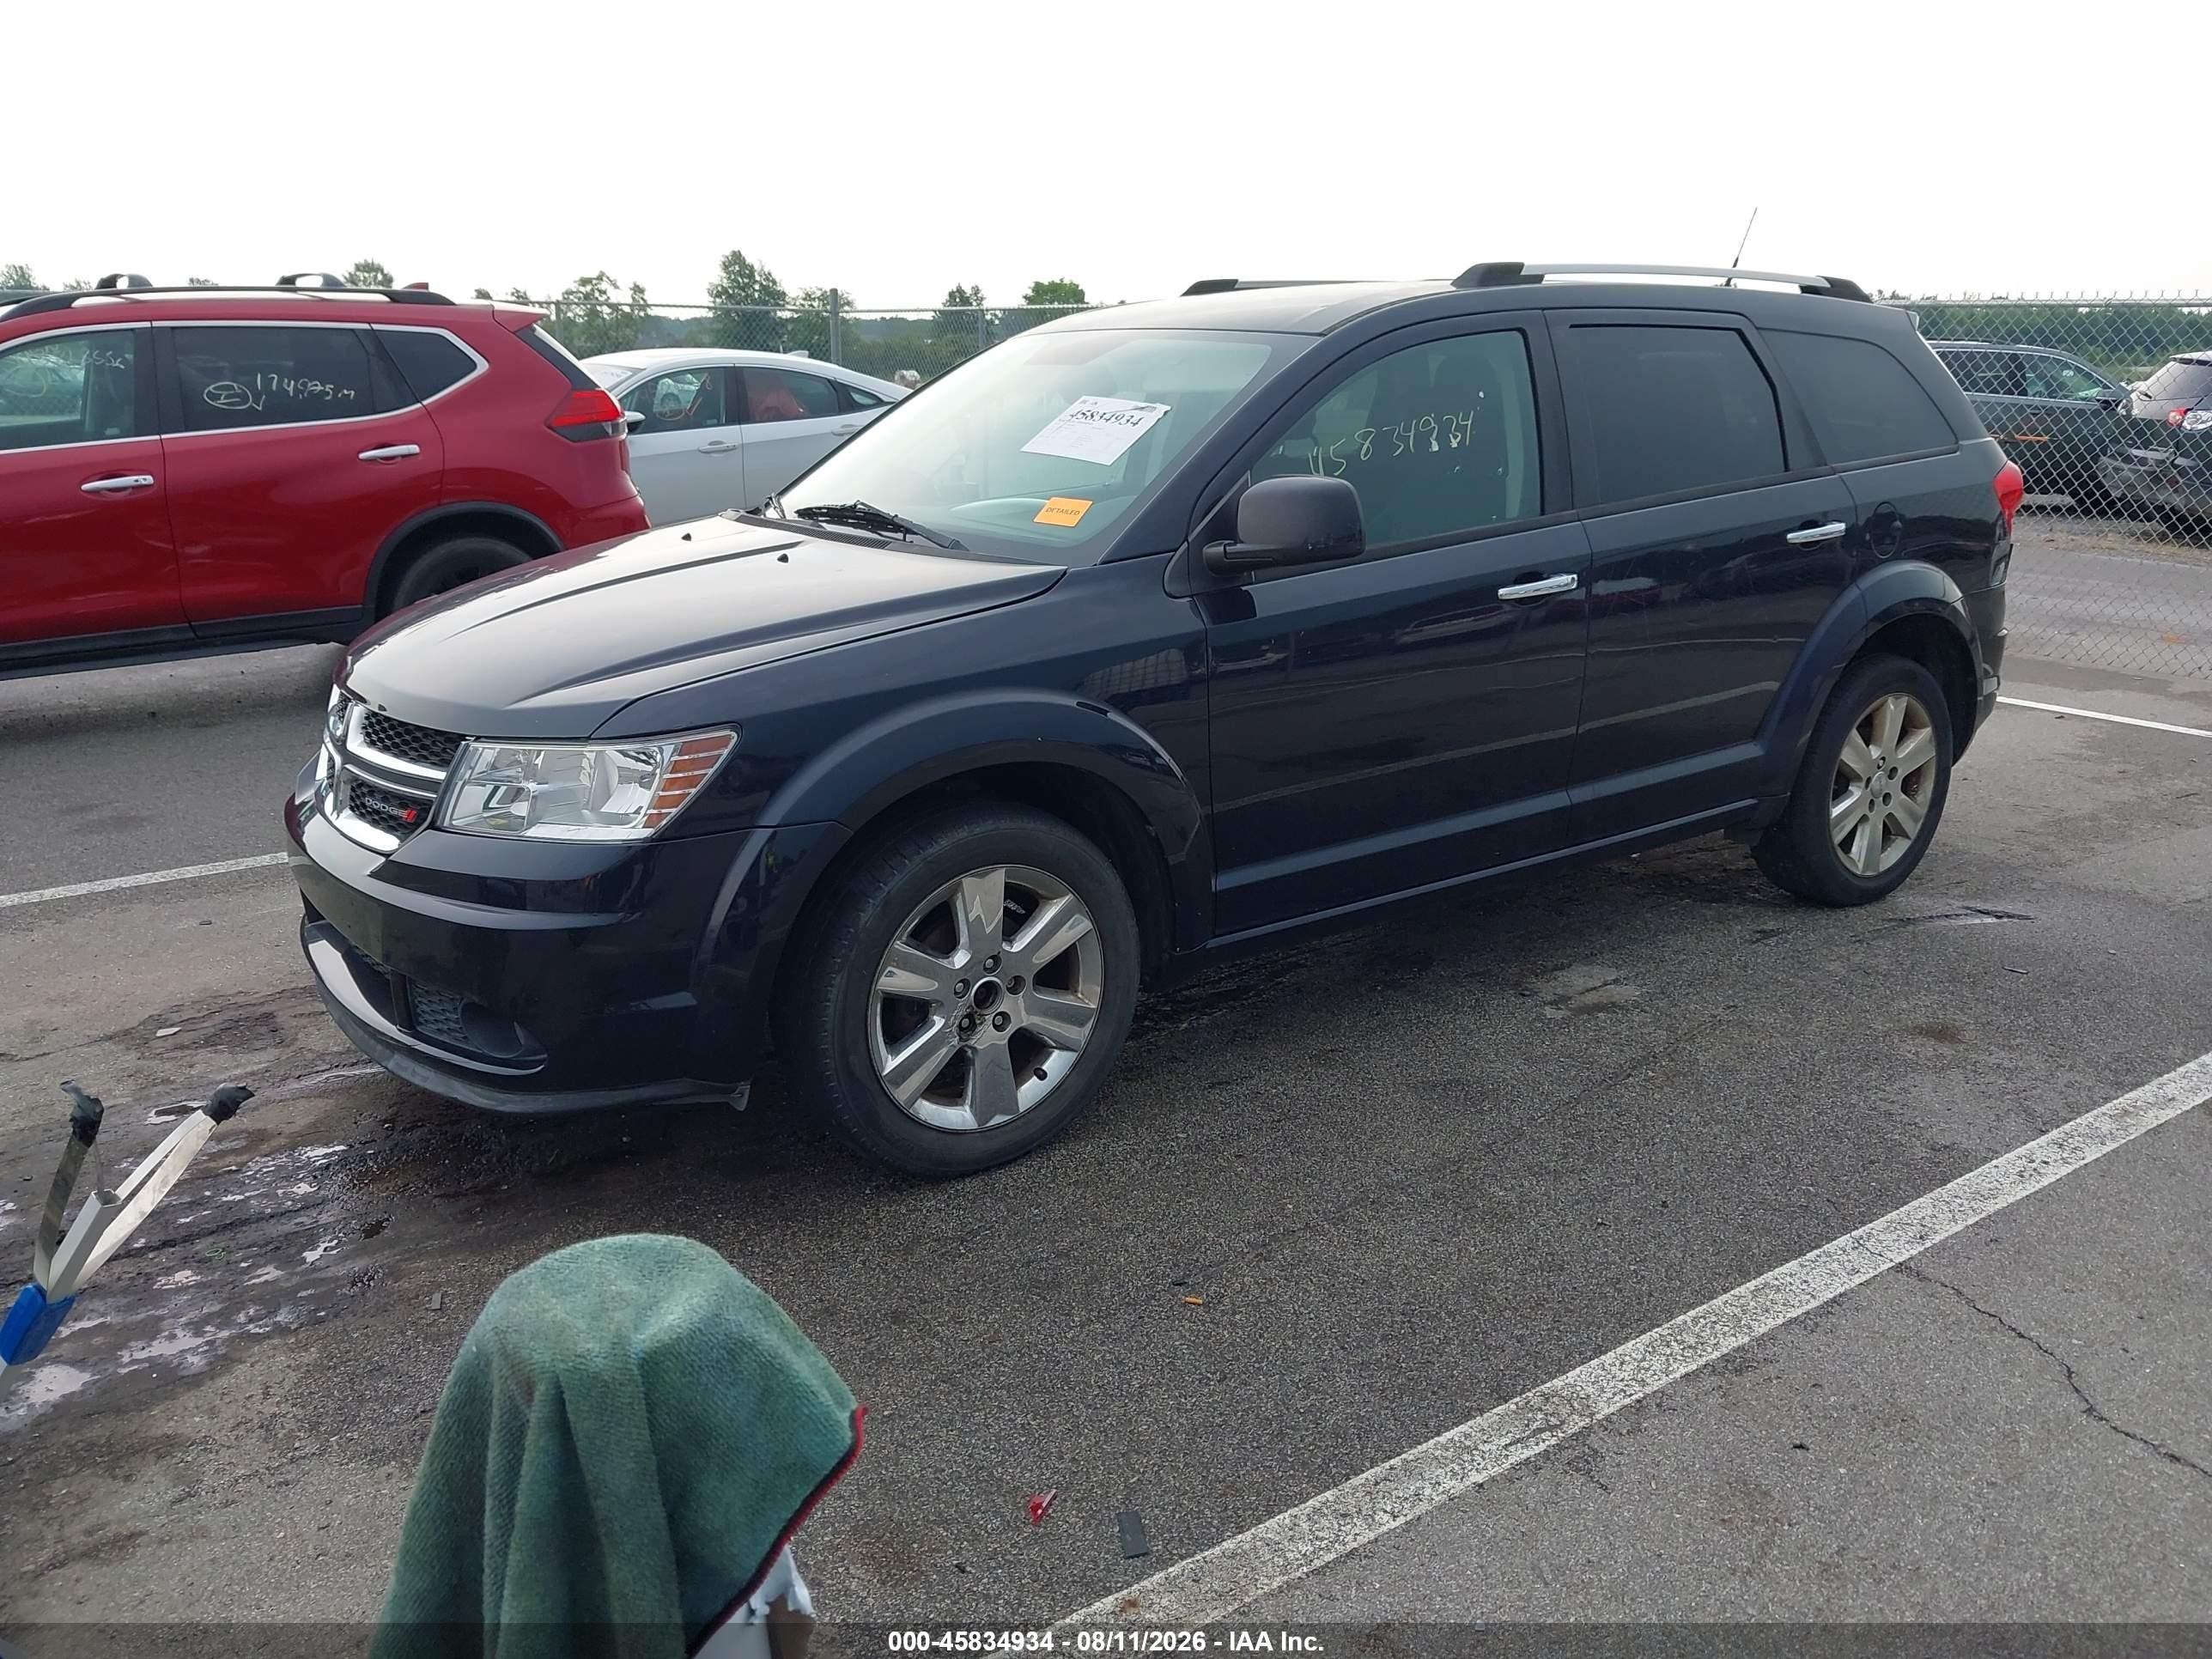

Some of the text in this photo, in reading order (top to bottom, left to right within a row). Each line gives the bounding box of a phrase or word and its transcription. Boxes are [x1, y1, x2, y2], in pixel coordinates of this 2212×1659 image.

[1070, 410, 1145, 427] 45834934
[1308, 410, 1474, 477] 45834934
[1045, 507, 1081, 516] DETAILED
[365, 797, 408, 818] DODGE
